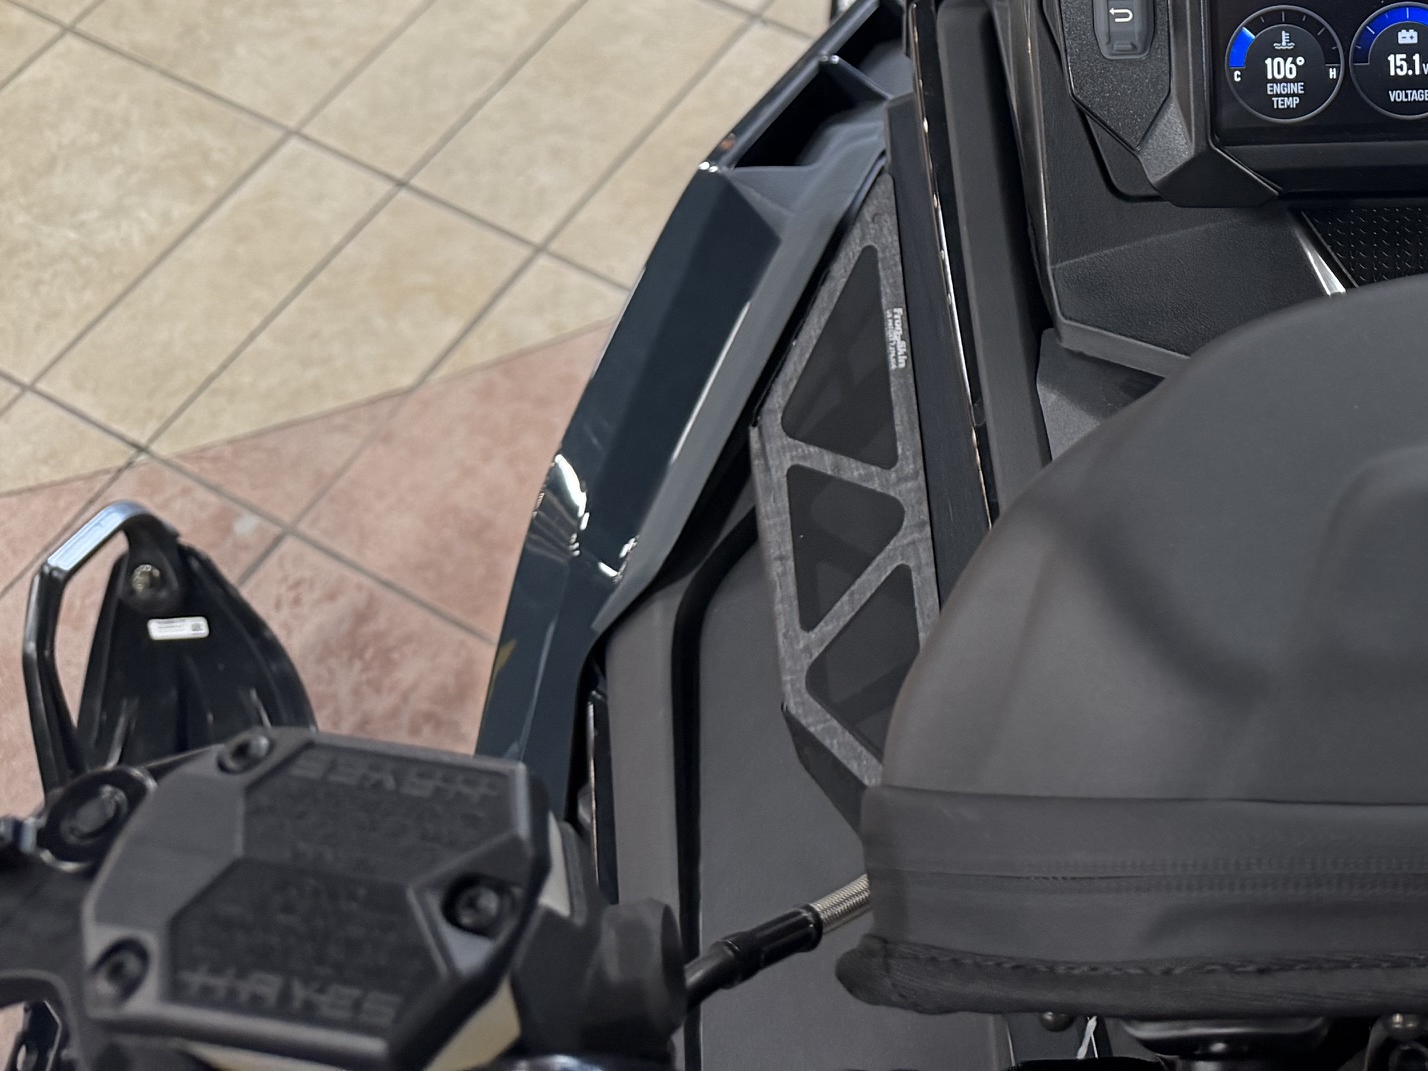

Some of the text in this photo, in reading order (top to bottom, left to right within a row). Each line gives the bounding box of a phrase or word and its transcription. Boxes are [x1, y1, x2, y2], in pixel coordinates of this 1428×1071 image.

[1264, 56, 1305, 80] 106°
[1329, 68, 1337, 79] H
[1234, 70, 1242, 82] C
[1266, 82, 1305, 95] ENGINE
[1271, 97, 1300, 109] TEMP
